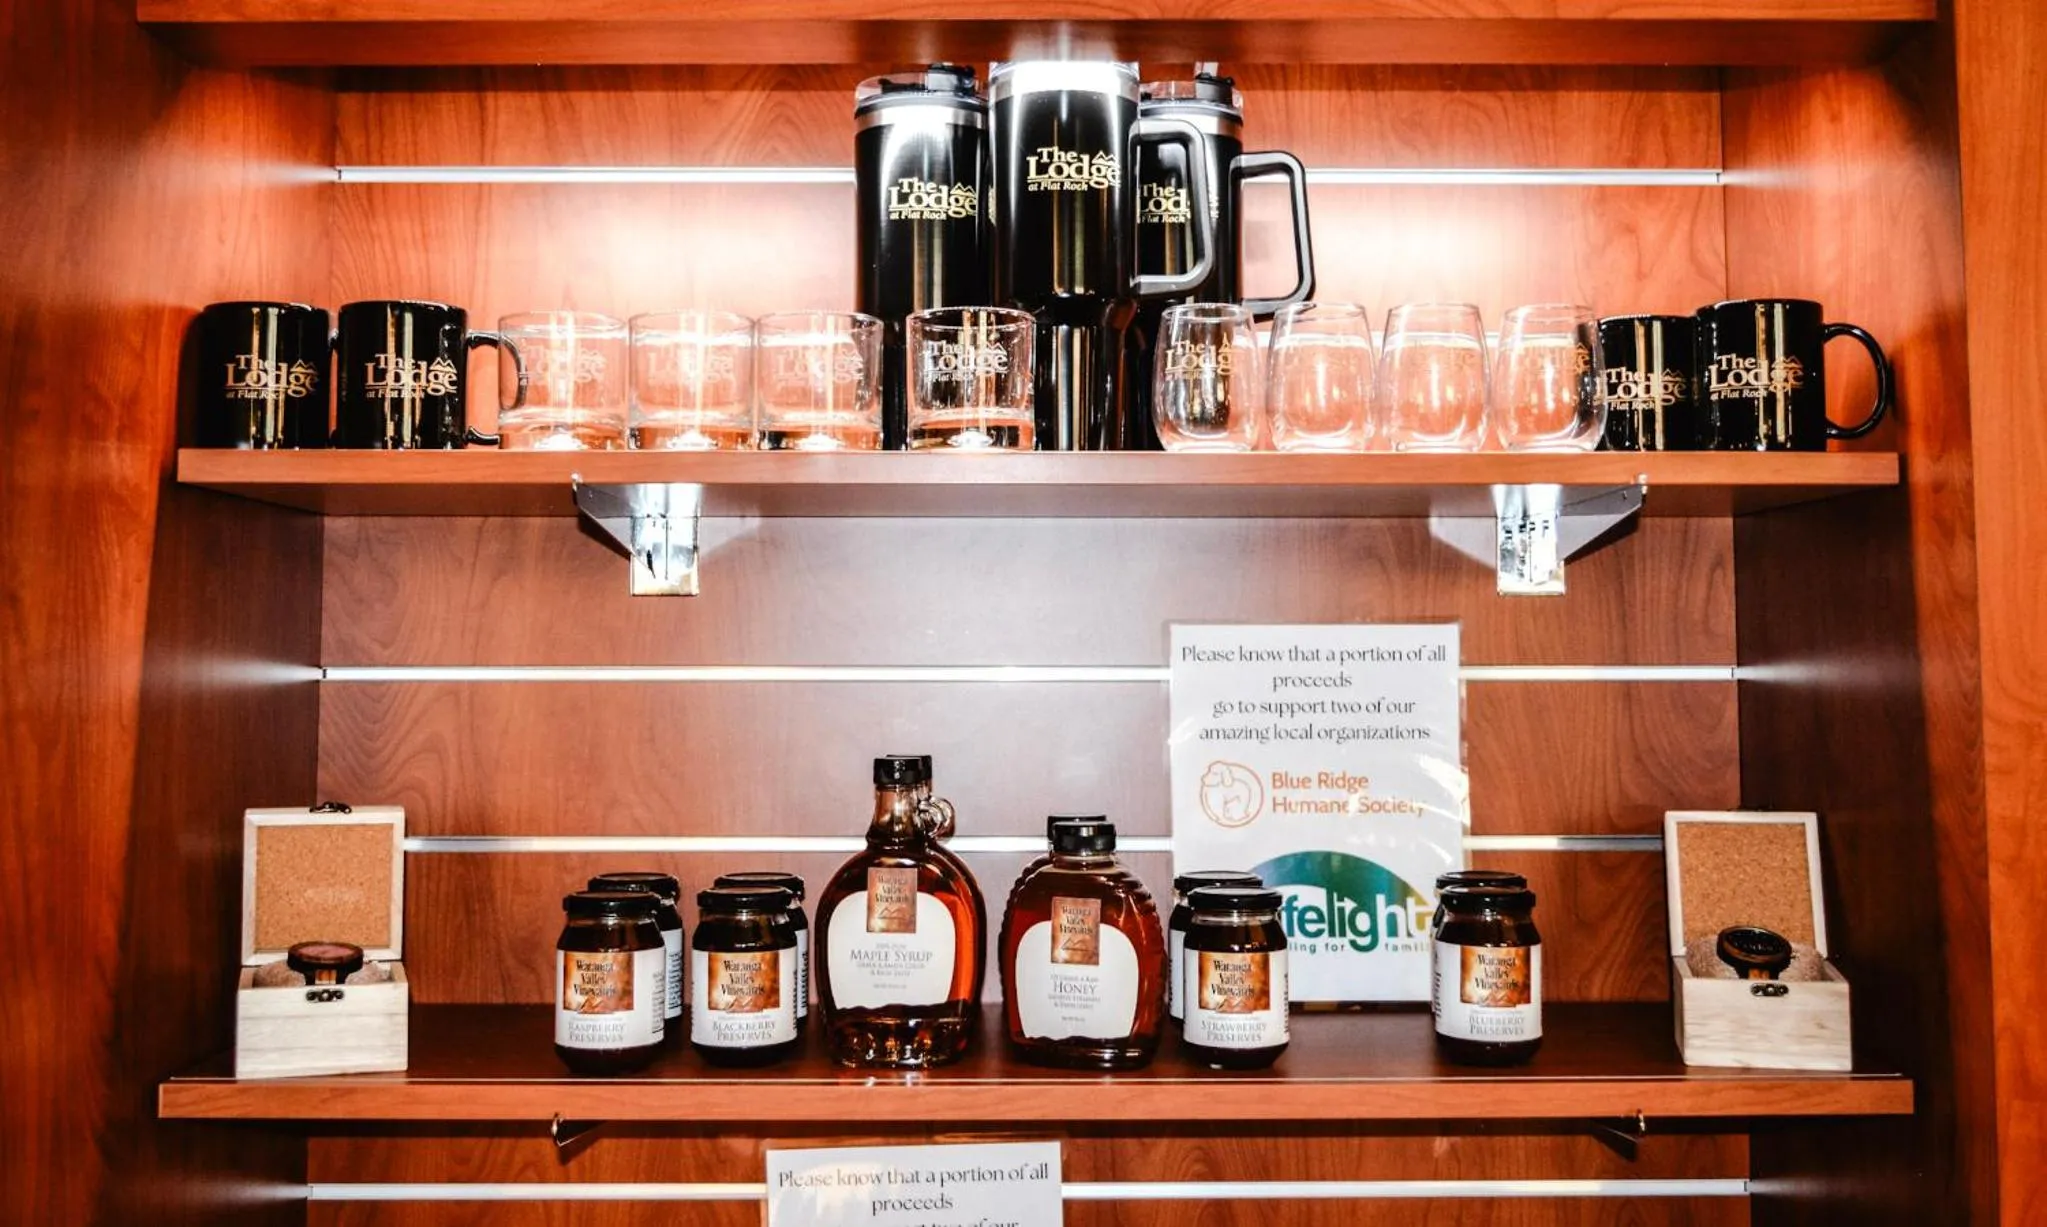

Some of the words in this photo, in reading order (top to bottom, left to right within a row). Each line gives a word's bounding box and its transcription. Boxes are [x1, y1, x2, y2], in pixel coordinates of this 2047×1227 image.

[1036, 145, 1078, 163] The
[1026, 153, 1120, 189] Lodge
[898, 176, 937, 193] The
[1040, 181, 1061, 191] Flat
[1064, 180, 1088, 191] Rock
[888, 185, 977, 218] Lodge
[901, 210, 921, 220] Flat
[923, 210, 947, 220] Rock
[928, 340, 966, 356] The
[1174, 340, 1206, 355] The
[922, 344, 1009, 377] Lodge
[1165, 344, 1234, 375] Lodg
[1716, 353, 1757, 370] The
[224, 360, 318, 398] Lodge
[364, 360, 458, 396] Lodge
[1708, 360, 1804, 393] Lodge
[1594, 372, 1687, 406] Lodge
[1721, 390, 1740, 399] Flat
[1182, 645, 1236, 662] Please
[1239, 645, 1284, 662] know
[1289, 645, 1321, 662] that
[1326, 650, 1336, 661] a
[1340, 646, 1403, 667] portion
[1406, 644, 1427, 661] of
[1427, 644, 1446, 661] all
[1272, 671, 1353, 692] proceeds
[1212, 701, 1235, 719] go
[1238, 700, 1257, 714] to
[1259, 700, 1327, 719] support
[1331, 700, 1362, 714] two
[1365, 696, 1386, 713] of
[1386, 701, 1416, 714] our
[1199, 726, 1270, 744] amazing
[1273, 722, 1313, 740] local
[1317, 725, 1431, 744] organizations
[1271, 771, 1312, 789] Blue
[1317, 770, 1370, 795] Ridge
[850, 949, 890, 962] MAPLE
[894, 950, 933, 962] SYRUP
[1325, 942, 1345, 952] for
[1053, 980, 1097, 995] HONEY
[779, 1168, 833, 1188] Please
[836, 1168, 884, 1186] know
[888, 1166, 921, 1185] that
[925, 1170, 936, 1183] a
[940, 1165, 1004, 1188] portion
[1007, 1162, 1028, 1180] of
[1029, 1162, 1049, 1180] all
[872, 1192, 954, 1216] proceeds
